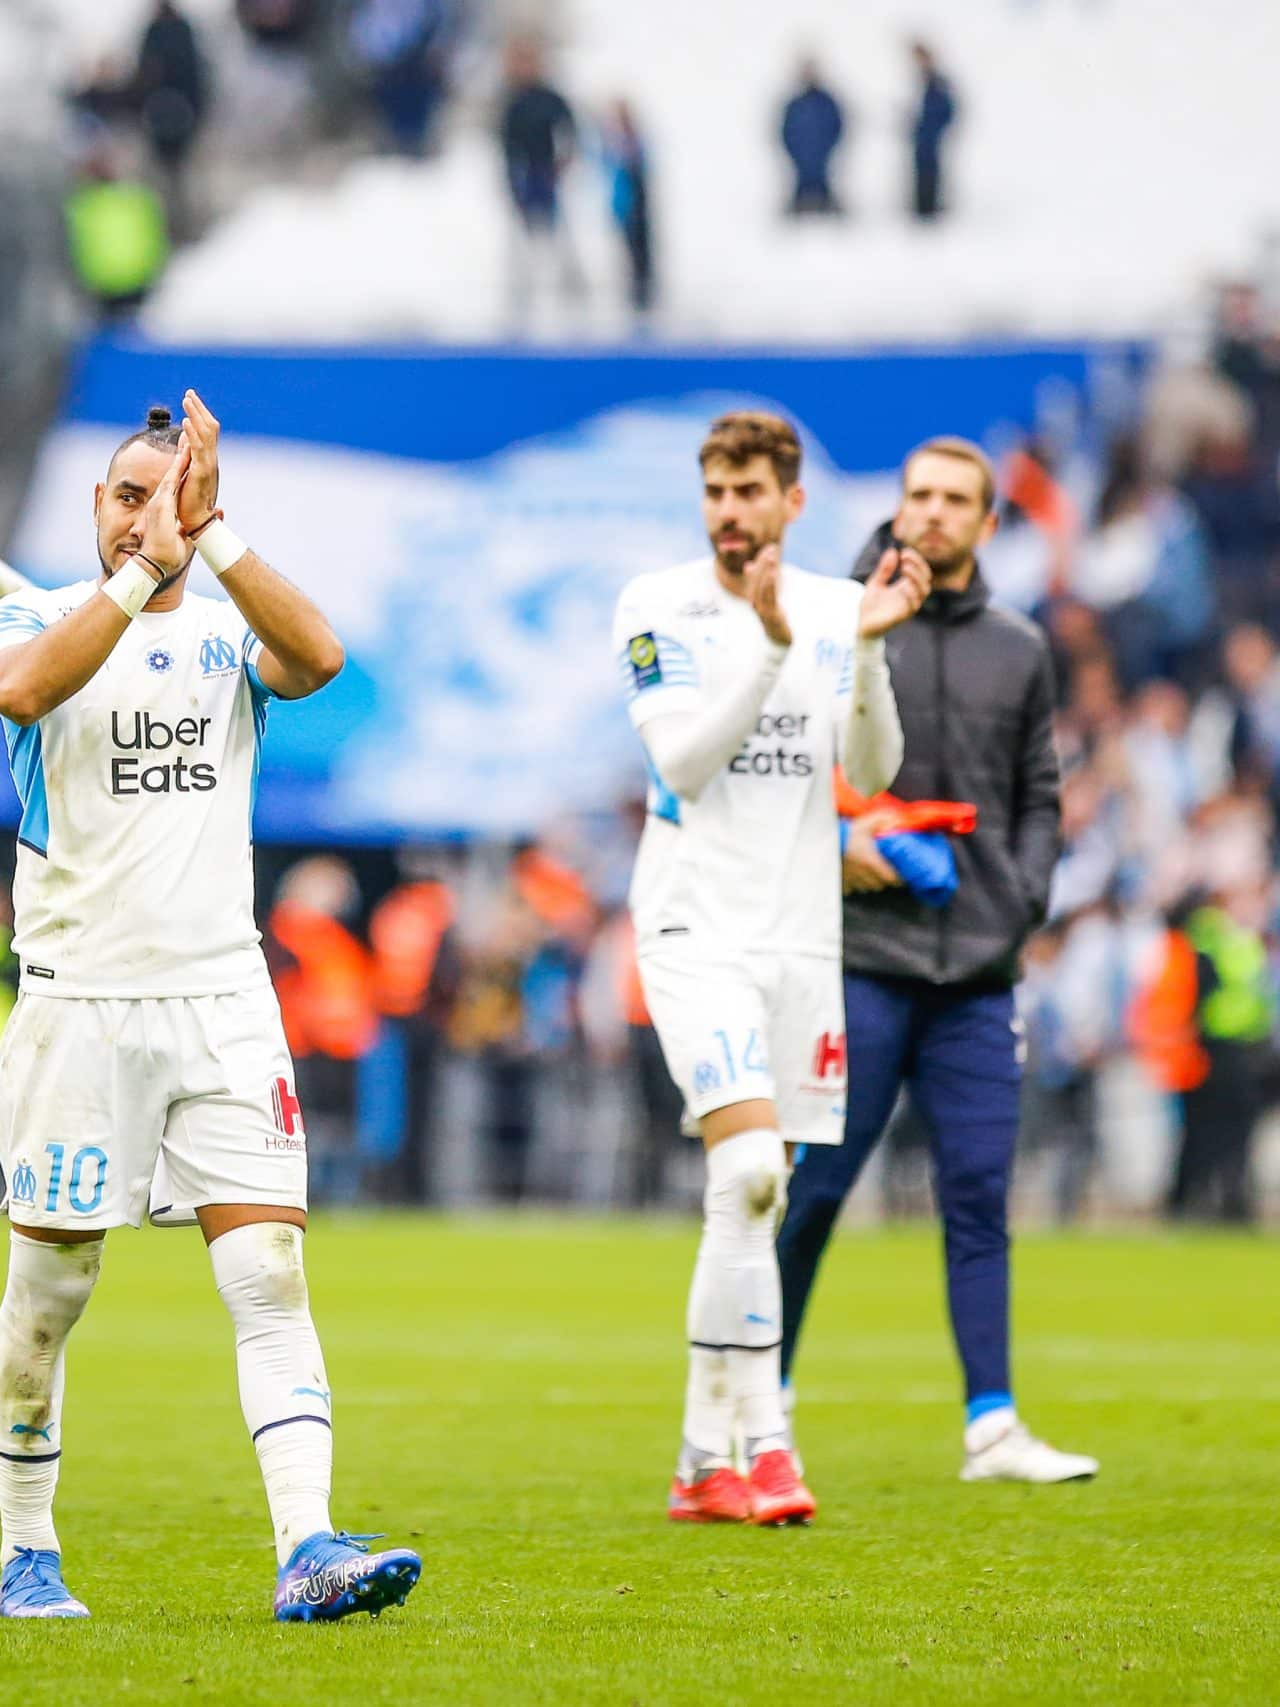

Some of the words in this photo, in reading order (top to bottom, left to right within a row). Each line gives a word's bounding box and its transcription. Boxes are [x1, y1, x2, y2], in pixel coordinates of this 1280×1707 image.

[111, 710, 212, 750] Uber
[755, 714, 811, 738] ber
[111, 756, 217, 795] Eats
[45, 1143, 108, 1213] 10
